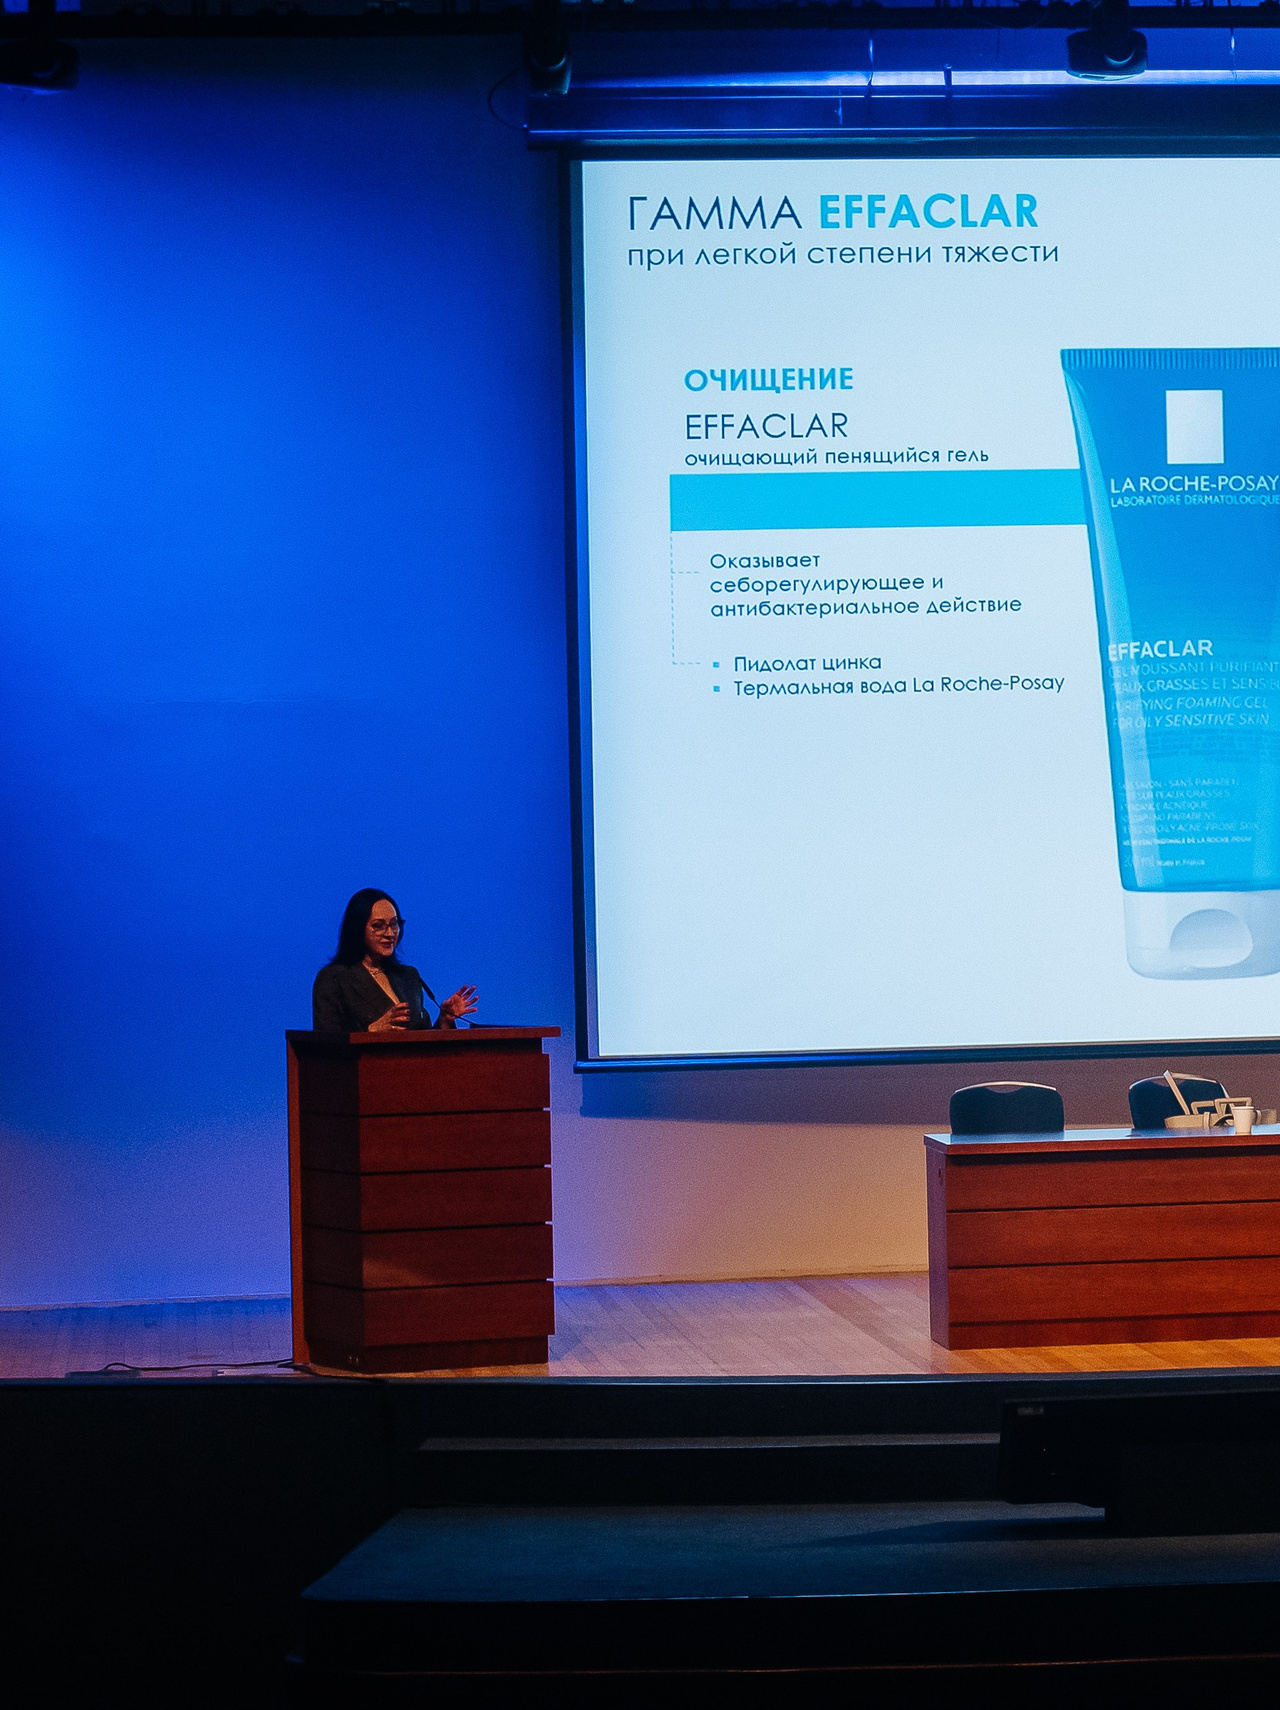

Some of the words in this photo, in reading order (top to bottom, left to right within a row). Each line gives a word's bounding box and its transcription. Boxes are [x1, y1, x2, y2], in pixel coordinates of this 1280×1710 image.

[629, 194, 803, 231] ГАММА
[819, 192, 1039, 229] EFFACLAR
[628, 248, 684, 272] при
[694, 241, 796, 265] легкой
[807, 246, 931, 264] степени
[941, 245, 1059, 263] тяжести
[684, 367, 854, 394] ОЧИЩЕНИЕ
[686, 412, 848, 440] EFFACLAR
[684, 448, 818, 467] очищающий
[825, 446, 940, 465] пенящийся
[947, 449, 989, 463] гель
[1111, 477, 1135, 494] LA
[1140, 475, 1280, 493] ROCHE-POSAY
[1111, 495, 1181, 508] LABORATOIRE
[1184, 494, 1280, 507] DERMATOLOGIQUE
[709, 553, 821, 570] Оказывает
[709, 576, 925, 596] себорегулирующее
[932, 577, 943, 590] и
[710, 600, 920, 619] антибактериальное
[926, 596, 1022, 615] действие
[1108, 639, 1214, 661] EFFACLAR
[734, 656, 817, 673] Пидолат
[822, 657, 882, 672] цинка
[733, 680, 854, 700] Термальная
[860, 680, 907, 695] вода
[913, 677, 935, 693] La
[941, 675, 1065, 694] Roche-Posay
[1147, 678, 1209, 692] GRASSES
[1212, 678, 1227, 690] ET
[1176, 696, 1242, 710] FOAMING
[1165, 713, 1234, 728] SENSITIVE
[1238, 712, 1270, 726] SKIN
